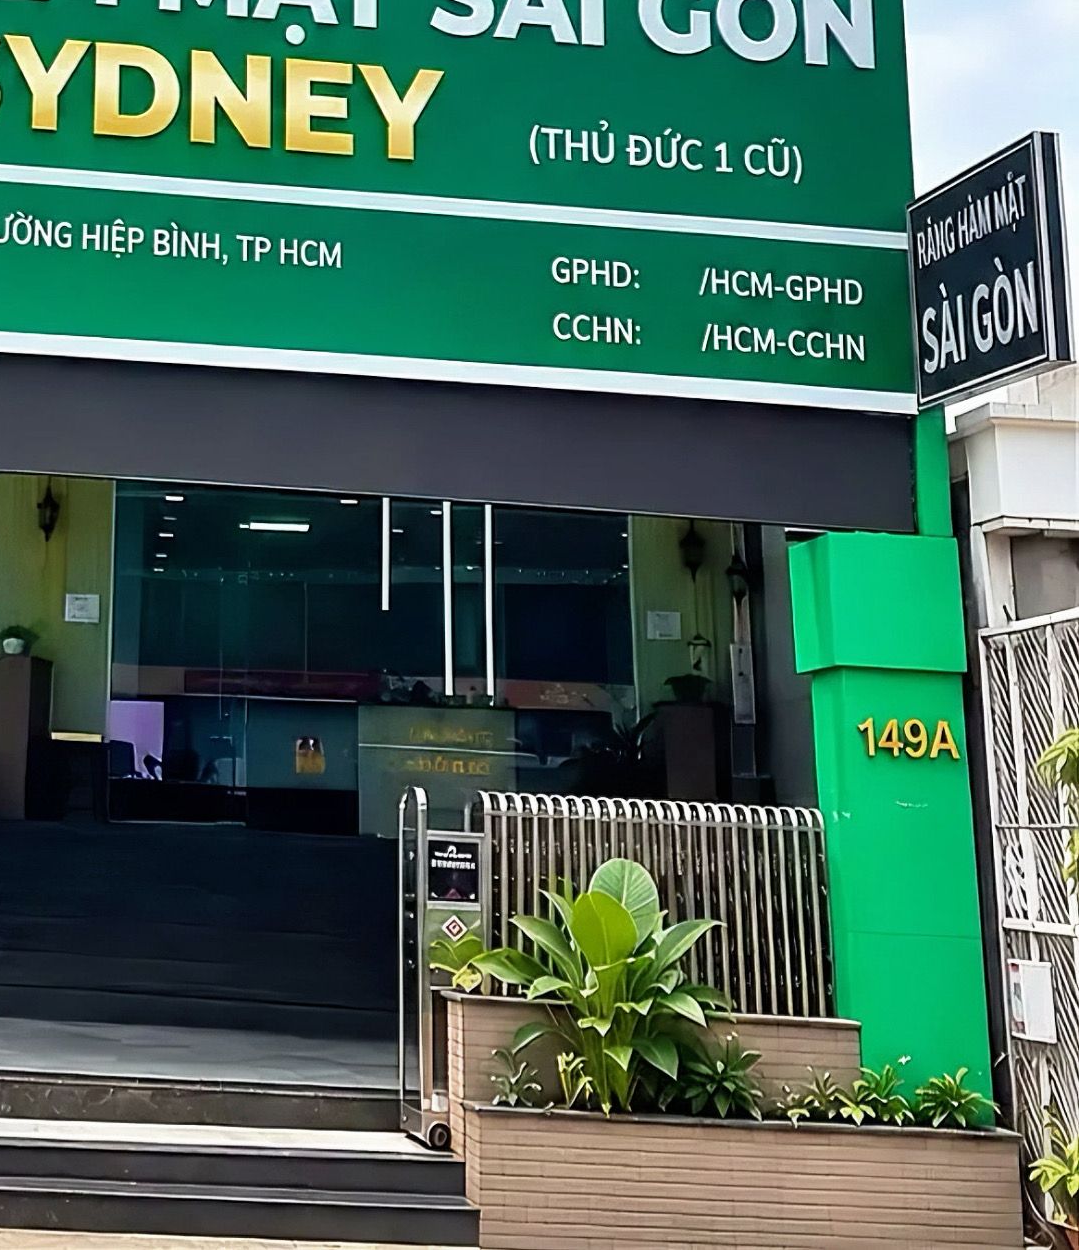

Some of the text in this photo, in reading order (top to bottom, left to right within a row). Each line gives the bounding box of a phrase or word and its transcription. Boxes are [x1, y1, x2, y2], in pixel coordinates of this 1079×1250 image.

[529, 120, 803, 184] (THỦ ĐỨC 1 CŨ)
[82, 218, 144, 259] HIỆP
[152, 222, 228, 265] BÌNH,
[236, 234, 272, 263] TP
[279, 238, 342, 269] HCM
[551, 256, 863, 305] GPHD: /HCM-GPHD
[552, 313, 865, 361] CCHN: /HCM-CCHN
[922, 256, 1039, 374] SÀI GÒN
[857, 717, 961, 760] 149A
